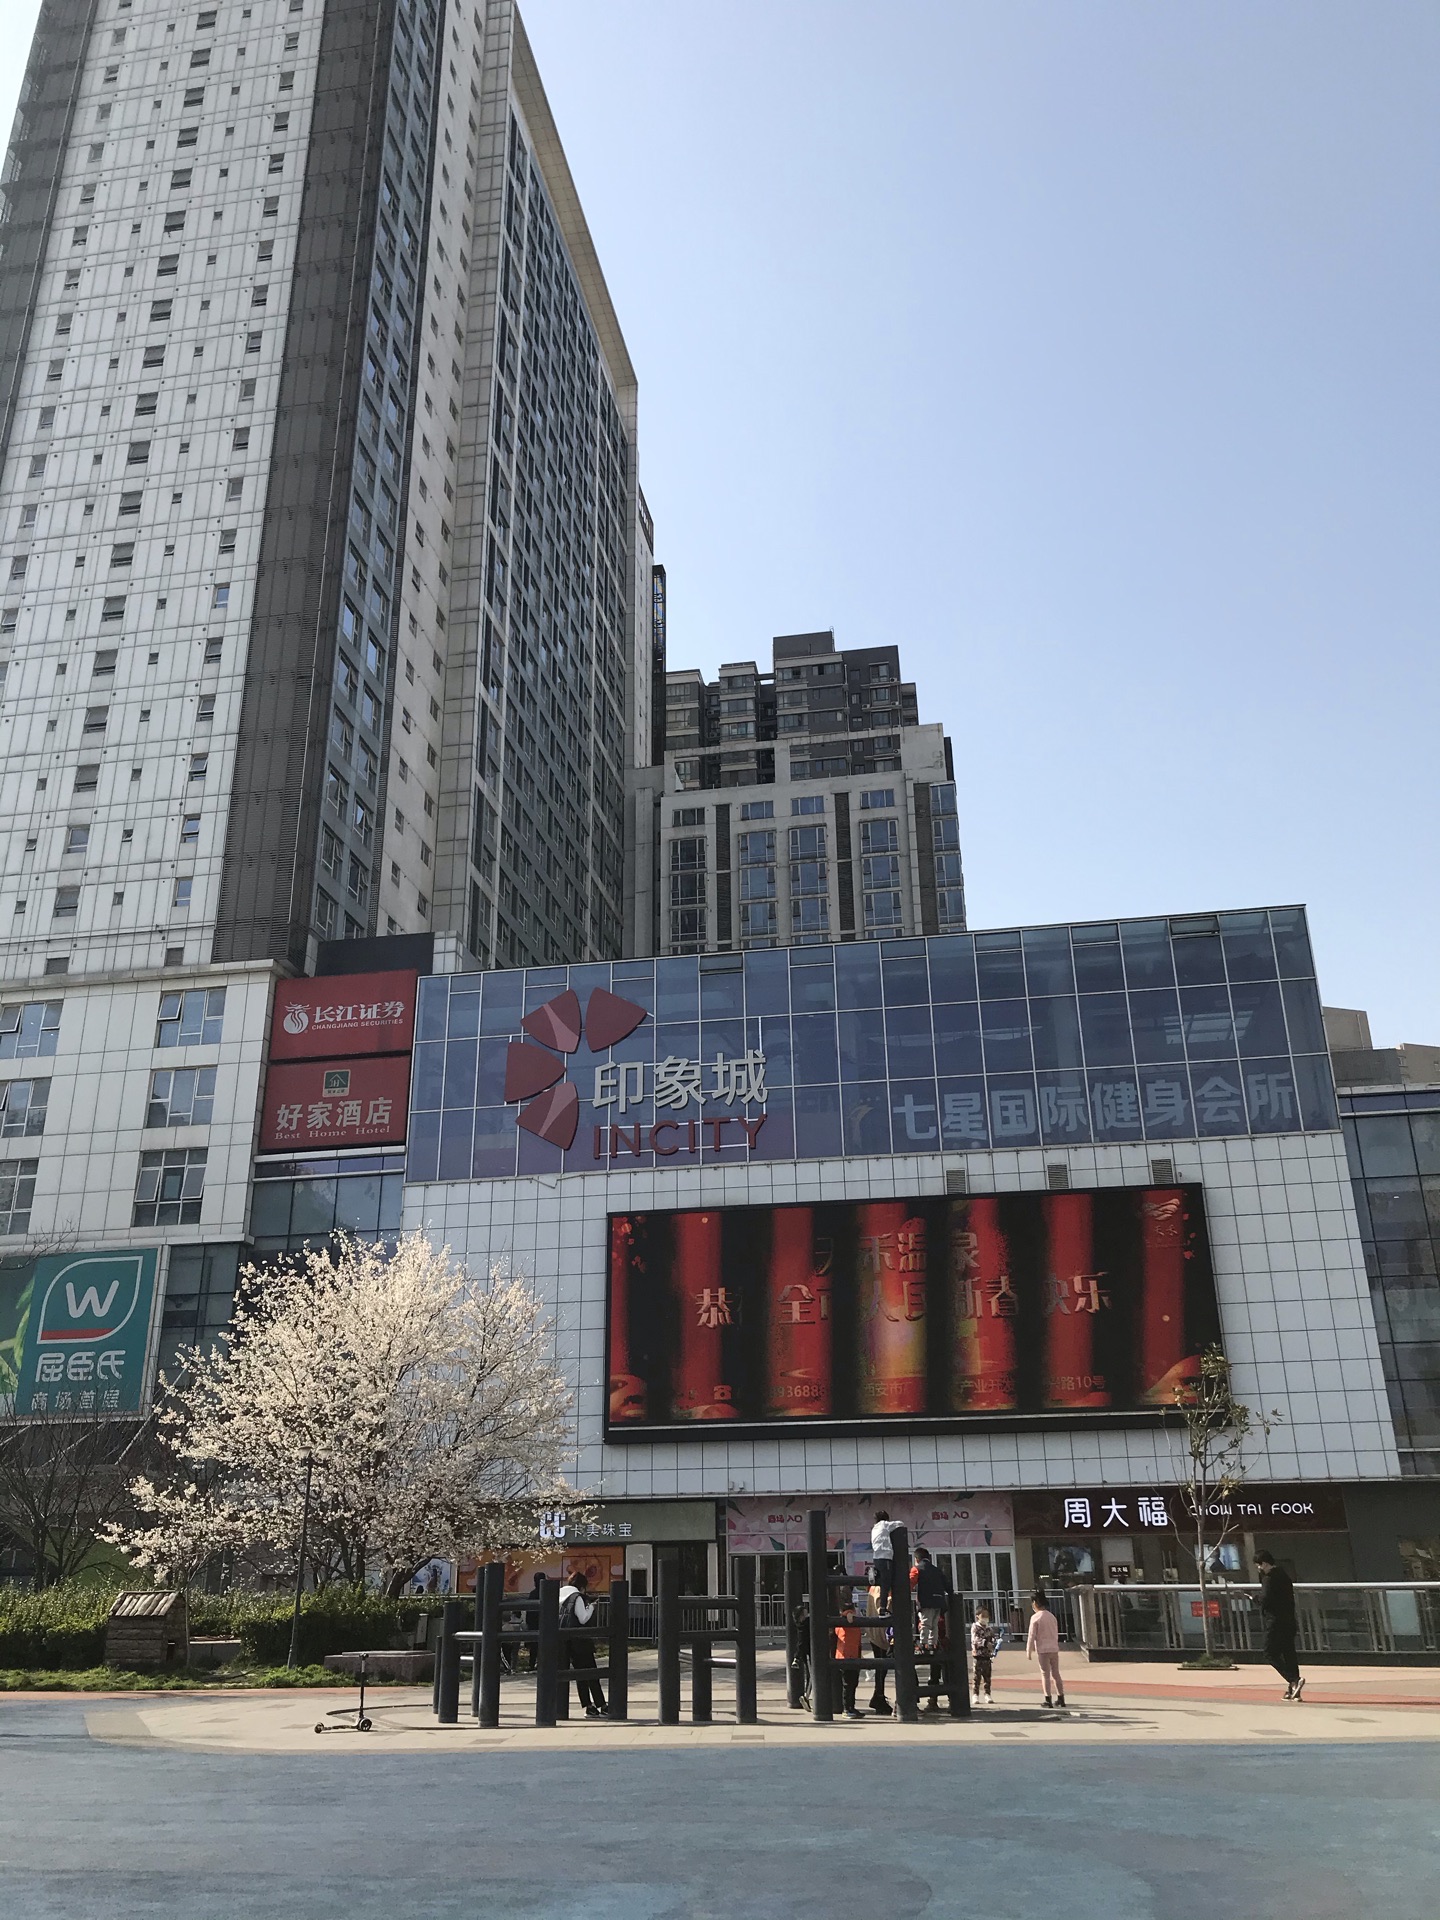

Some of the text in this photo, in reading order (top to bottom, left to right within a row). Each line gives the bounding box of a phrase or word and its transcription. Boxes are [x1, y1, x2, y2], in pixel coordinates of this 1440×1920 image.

[312, 1018, 403, 1030] CHANGJIANG SECURITIES
[313, 1001, 405, 1023] 长江证券
[592, 1049, 769, 1113] 印象城
[276, 1097, 393, 1131] 好家酒店
[893, 1071, 1298, 1141] 七星国际健身会所
[275, 1126, 390, 1140] Best Home Hotel
[593, 1113, 768, 1159] INCITY
[35, 1349, 126, 1382] 屈臣氏
[1064, 1497, 1168, 1528] 周大福
[1236, 1503, 1263, 1515] TAI
[1270, 1502, 1314, 1515] FOOK
[571, 1522, 632, 1538] 卡美珠宝
